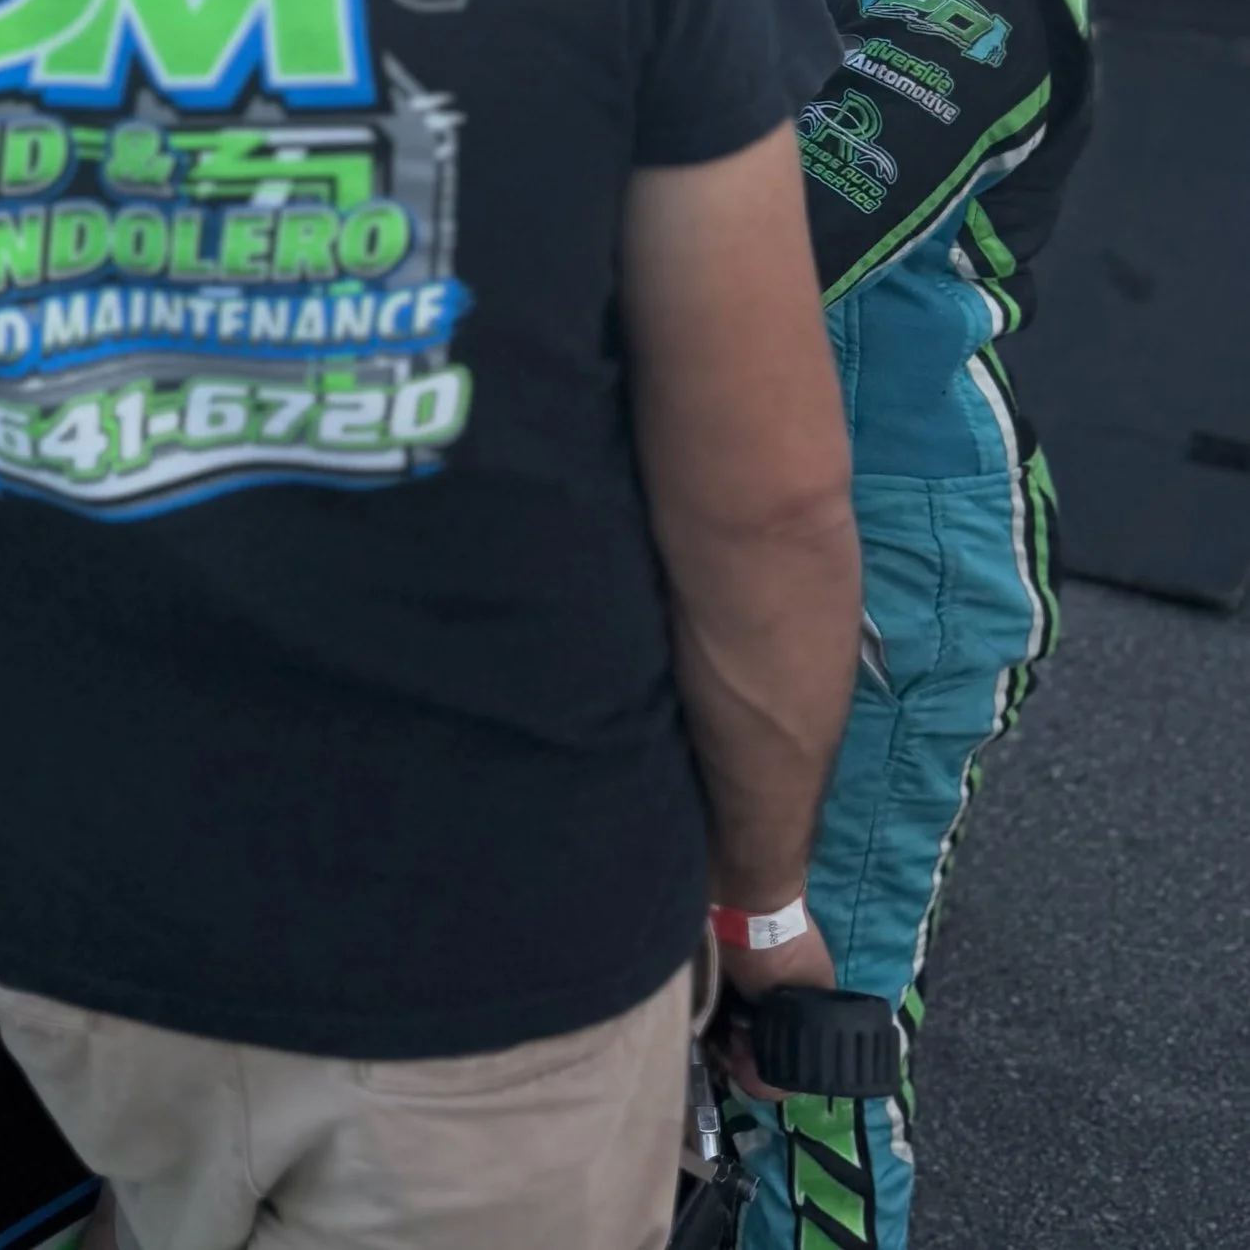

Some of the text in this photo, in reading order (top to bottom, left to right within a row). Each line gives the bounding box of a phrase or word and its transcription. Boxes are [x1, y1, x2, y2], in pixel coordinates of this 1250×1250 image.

[847, 53, 957, 121] Automotive
[104, 119, 175, 197] &
[811, 163, 877, 211] SERVICE
[841, 166, 882, 197] AUTO
[40, 281, 447, 353] MAINTENANCE
